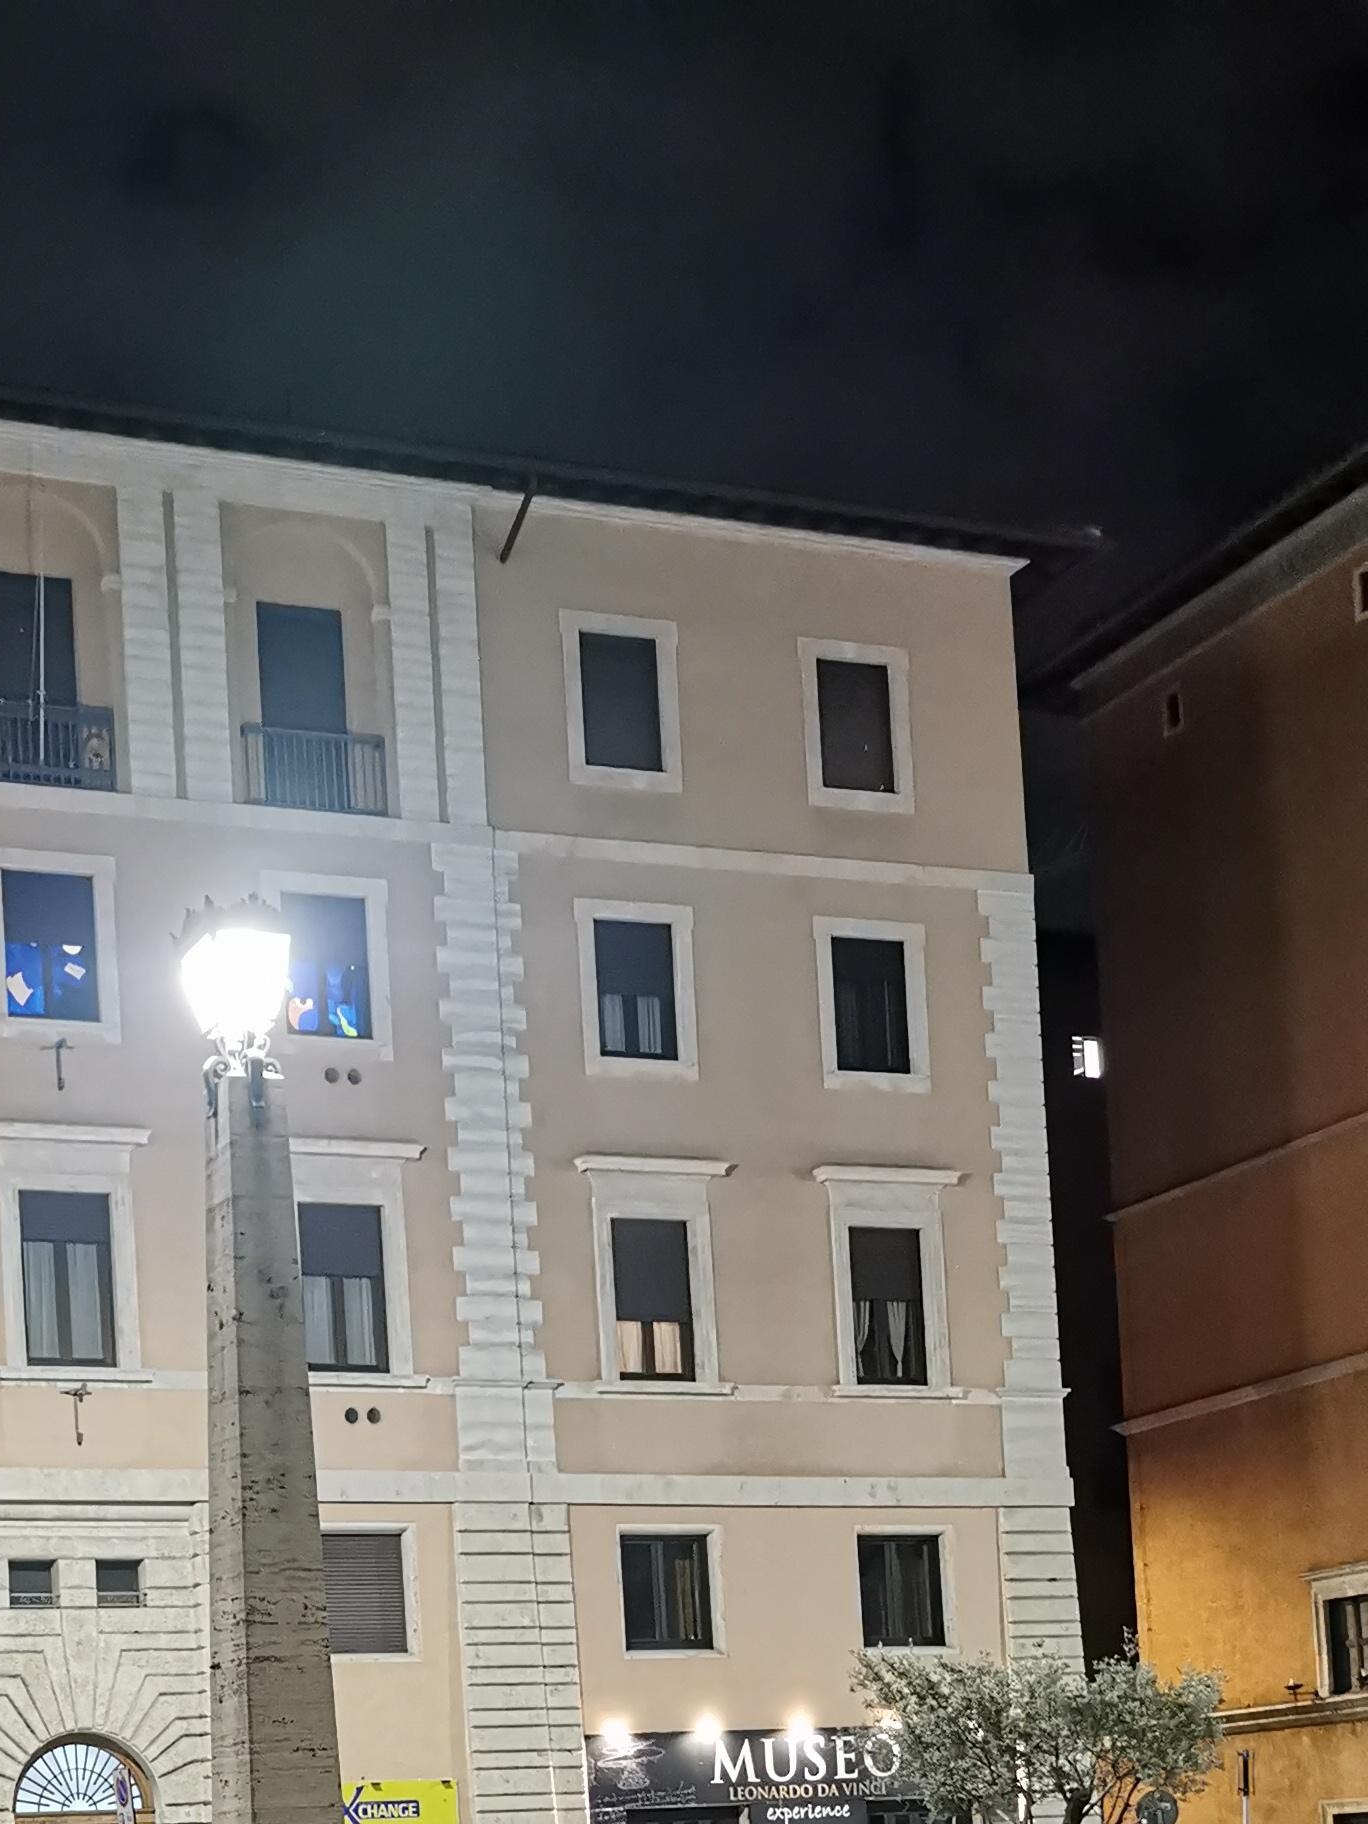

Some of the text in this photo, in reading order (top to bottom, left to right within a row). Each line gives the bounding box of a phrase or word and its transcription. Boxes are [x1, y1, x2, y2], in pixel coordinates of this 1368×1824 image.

[710, 1733, 901, 1784] MUSEO
[729, 1780, 888, 1801] LEONARDO DA VINCI
